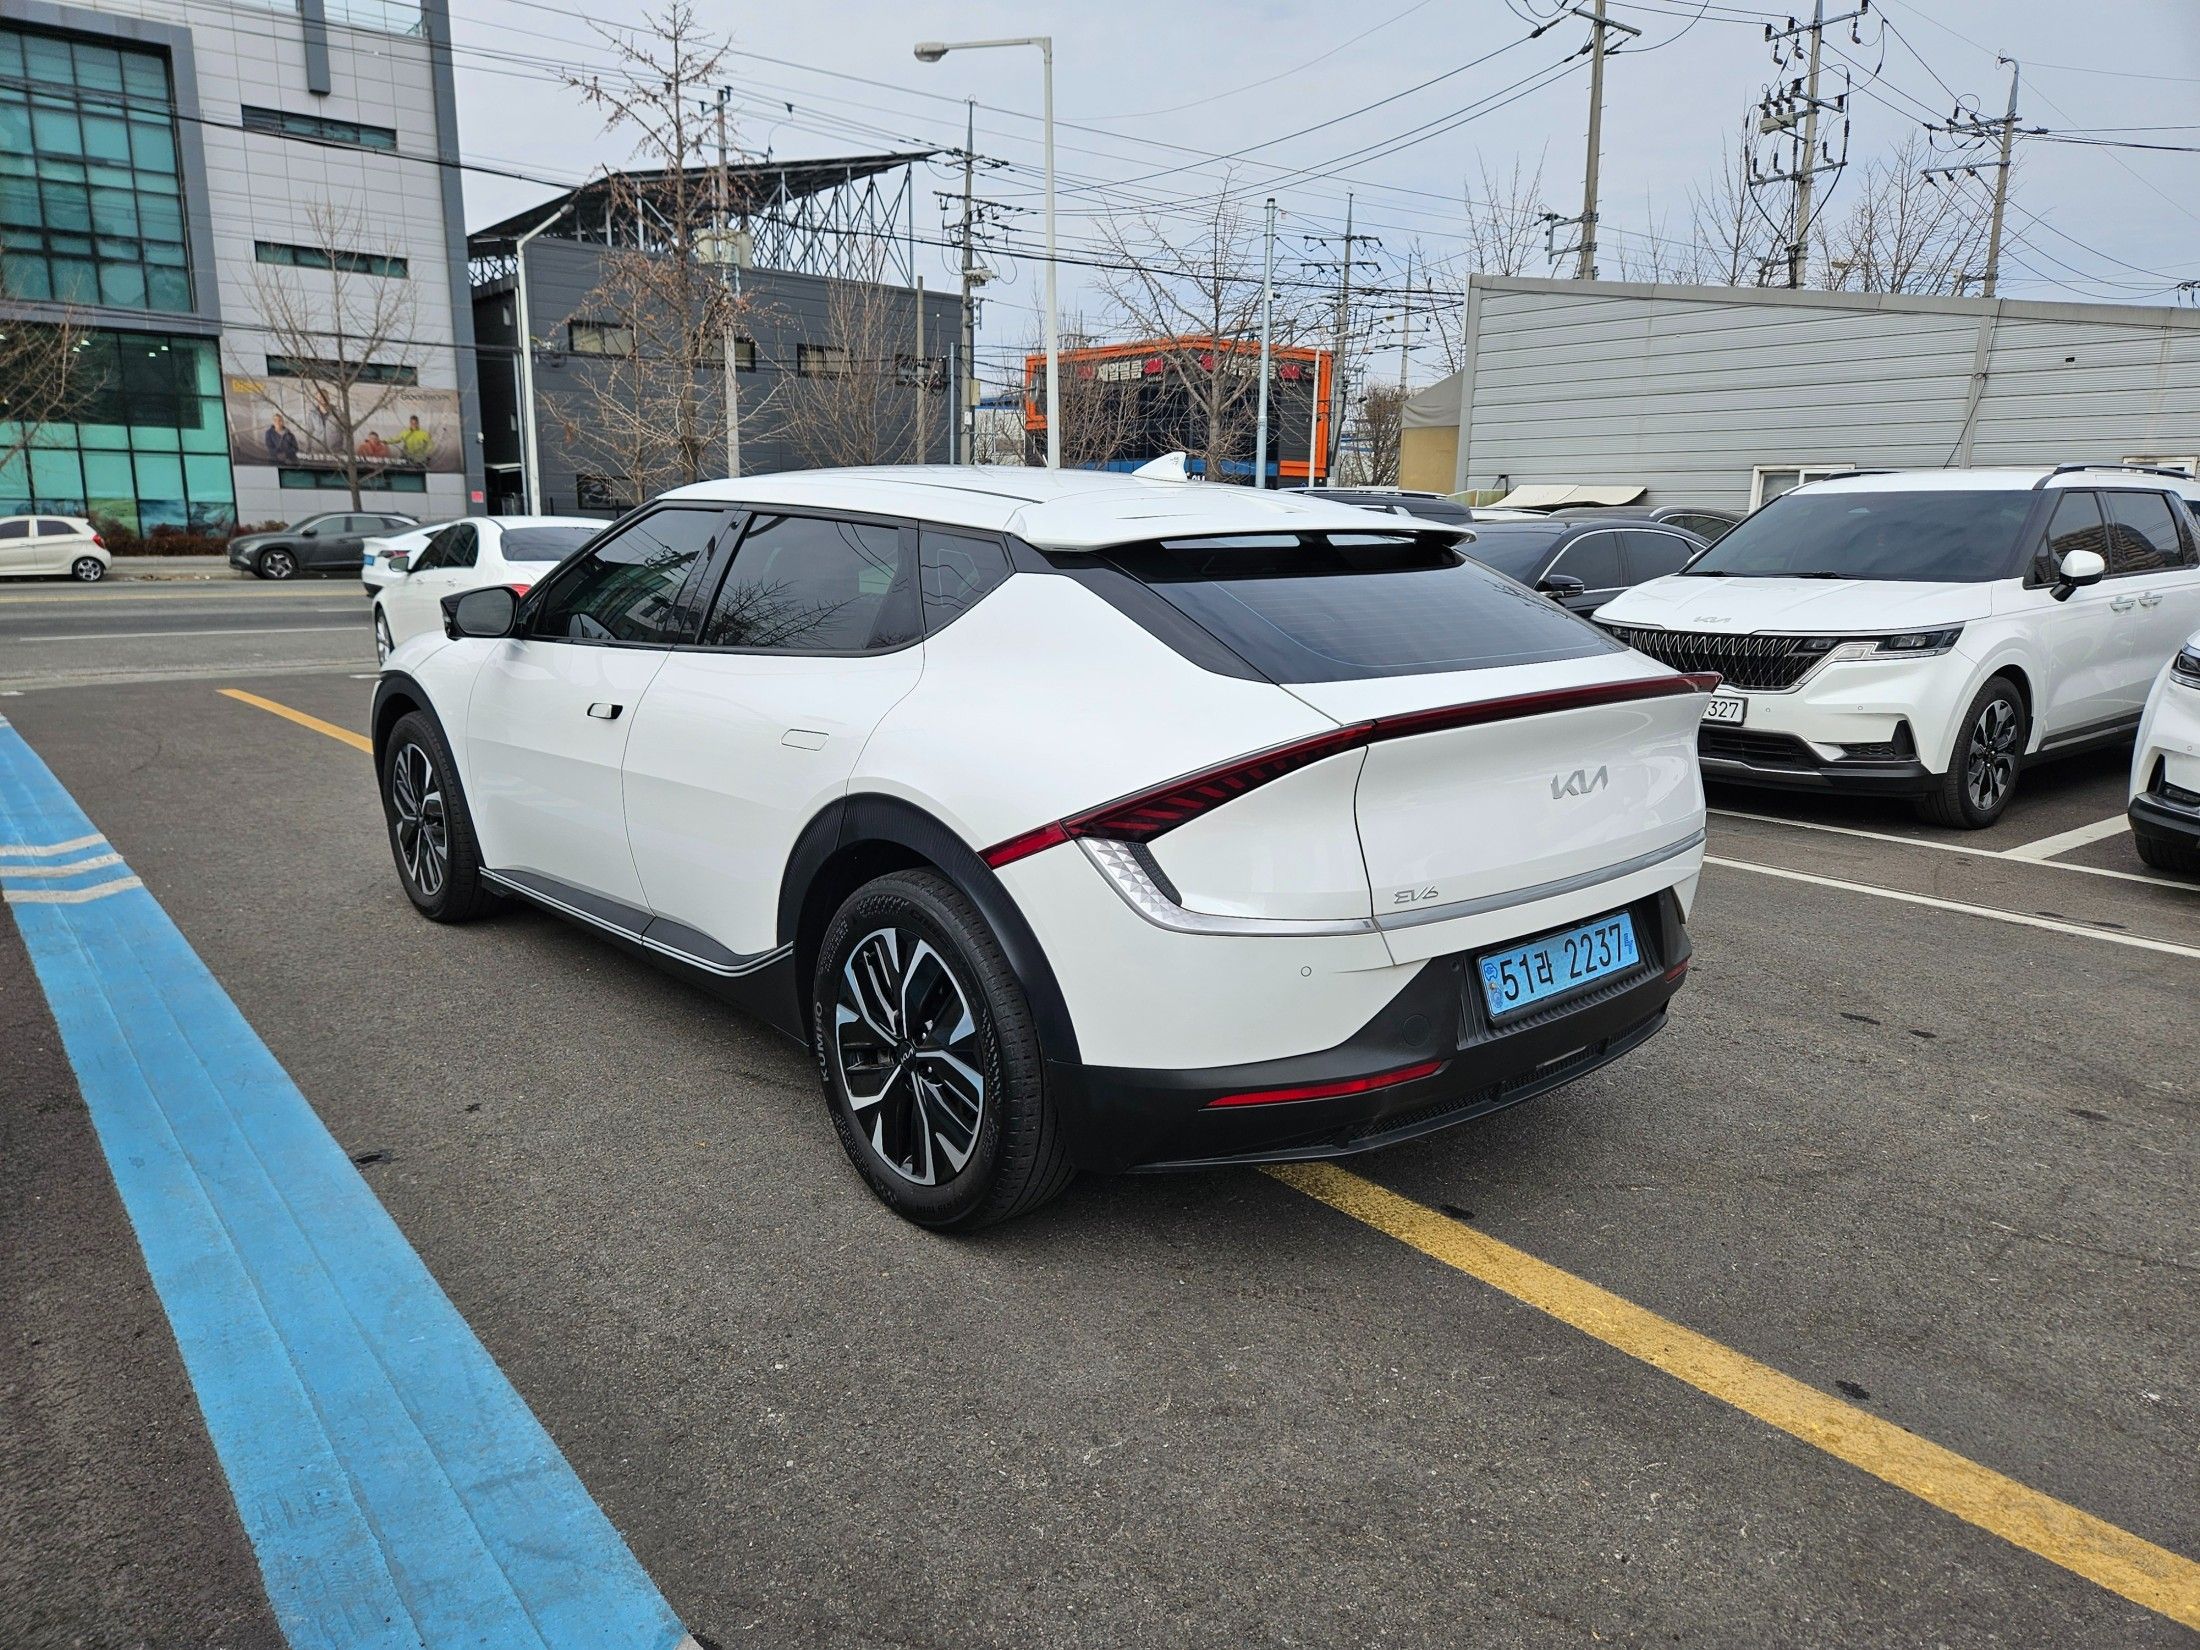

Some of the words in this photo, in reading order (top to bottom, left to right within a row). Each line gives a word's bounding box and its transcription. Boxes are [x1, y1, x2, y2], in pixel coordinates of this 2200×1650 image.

[1551, 765, 1609, 800] KIA
[1393, 885, 1439, 904] EV6
[1500, 950, 1555, 1001] 51라
[1564, 922, 1621, 979] 2237
[816, 1001, 830, 1082] KUMHO
